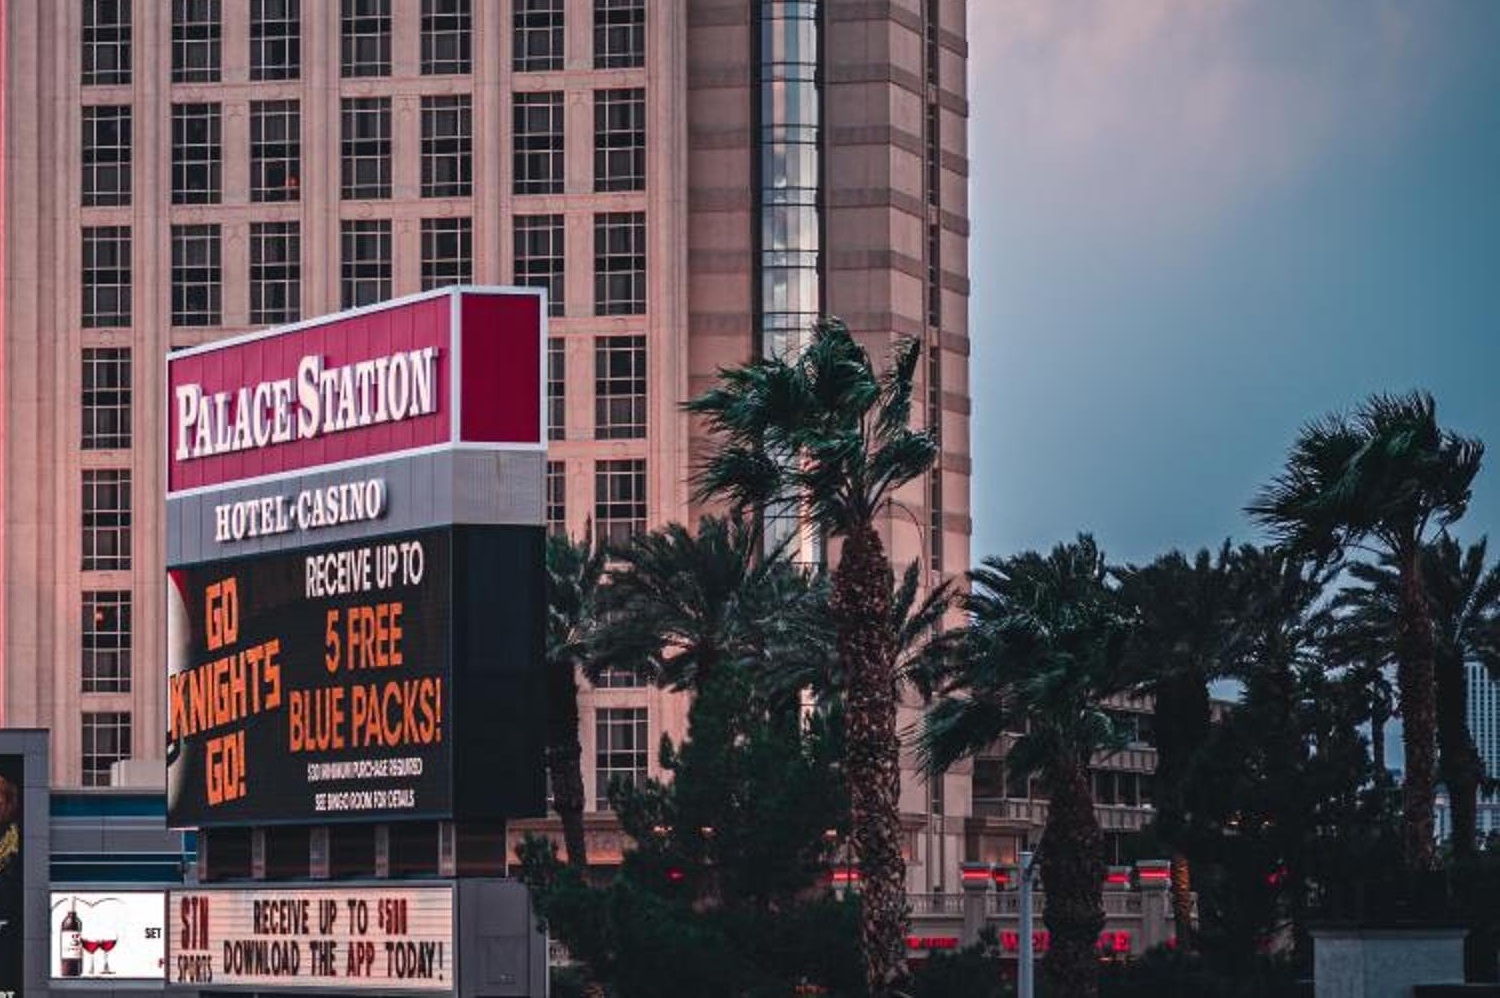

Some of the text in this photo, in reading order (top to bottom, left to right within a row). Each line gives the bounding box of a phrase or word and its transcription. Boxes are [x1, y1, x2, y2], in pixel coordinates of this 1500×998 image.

[175, 346, 437, 462] PALACE STATION
[215, 478, 386, 541] HOTEL CASINO
[305, 540, 424, 598] RECEIVE UP TO
[205, 576, 239, 651] GO
[325, 602, 404, 674] 5 FREE
[169, 638, 282, 741] KNIGHTS
[288, 676, 442, 752] BLUE PACKS!
[205, 729, 246, 805] GO!
[354, 760, 388, 778] PURCHASE
[144, 927, 162, 939] SET
[253, 899, 309, 936] RECEIVE
[318, 899, 337, 936] UP
[346, 899, 368, 936] TO
[223, 940, 444, 981] DOWNLOAD THE APP TODAY!
